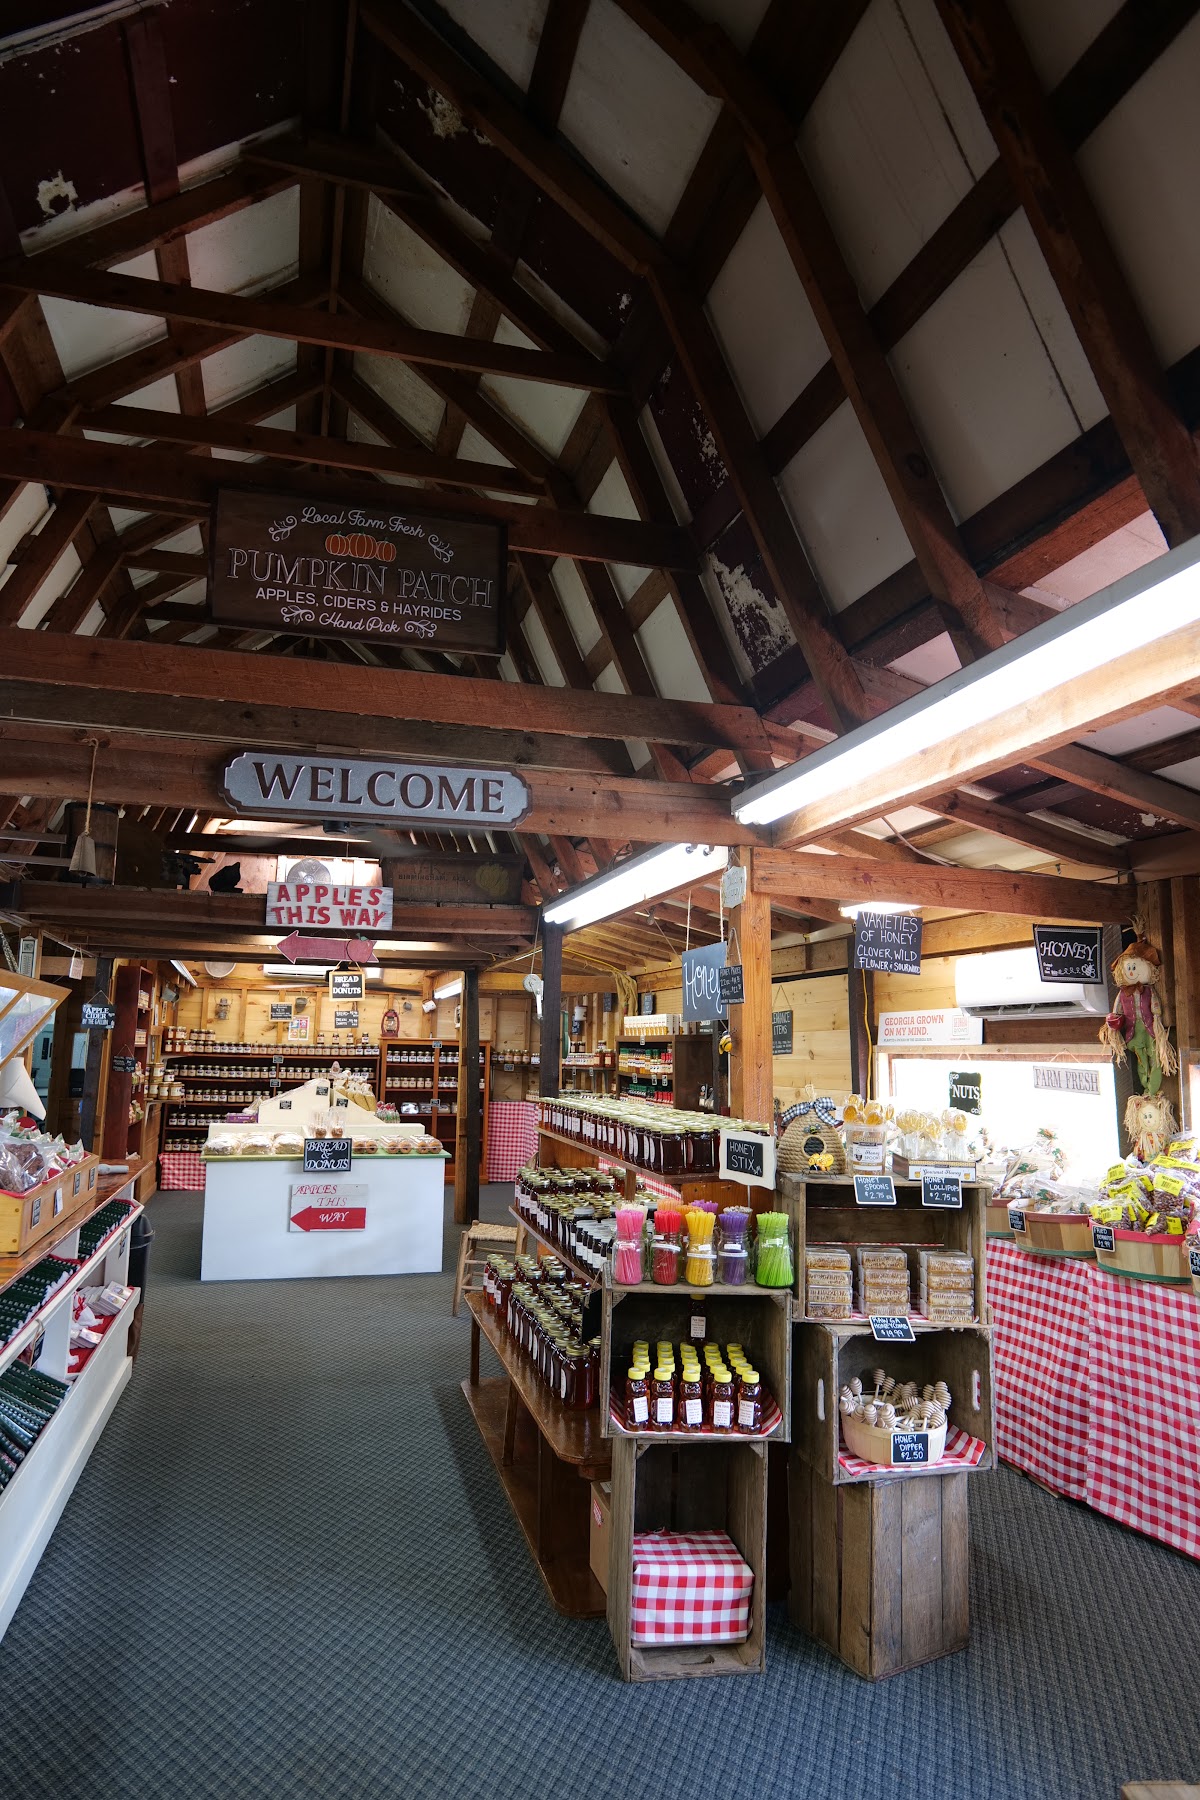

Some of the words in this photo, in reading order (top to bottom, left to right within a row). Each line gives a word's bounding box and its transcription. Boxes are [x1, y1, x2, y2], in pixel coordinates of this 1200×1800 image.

[301, 506, 346, 525] Local
[348, 509, 387, 530] Farm
[389, 515, 425, 538] Fresh
[227, 547, 388, 595] PUMPKIN
[397, 568, 493, 608] PATCH
[255, 587, 319, 606] APPLES,
[323, 594, 376, 612] CIDERS
[380, 600, 389, 613] &
[393, 602, 462, 621] HAYRIDES
[319, 612, 365, 631] Hand
[366, 617, 400, 633] Pick
[252, 761, 505, 815] WELCOME
[276, 884, 383, 906] APPLES
[271, 905, 331, 924] THIS
[339, 908, 387, 928] WAY
[861, 911, 918, 933] VARIETIES
[860, 929, 875, 943] OF
[880, 929, 916, 945] HONEY:
[857, 944, 893, 960] CLOVER,
[894, 948, 917, 961] WILD
[1040, 940, 1098, 961] HONEY
[334, 975, 359, 983] BREAD
[683, 958, 722, 1014] Honey
[885, 1016, 914, 1026] GEORGIA
[916, 1014, 944, 1024] GROWN
[773, 1025, 788, 1035] ITEMS
[884, 1028, 894, 1036] ON
[896, 1028, 906, 1036] MY
[908, 1027, 928, 1036] MIND.
[1035, 1068, 1061, 1088] FARM
[1065, 1071, 1099, 1092] FRESH
[951, 1084, 980, 1100] NUTS
[307, 1141, 347, 1152] BREAD
[730, 1141, 755, 1157] HONEY
[321, 1151, 333, 1159] &
[731, 1154, 755, 1170] STIX
[306, 1158, 349, 1169] DONUTS
[944, 1169, 962, 1177] Honey
[293, 1184, 337, 1196] APPLES
[317, 1197, 347, 1207] THIS
[319, 1211, 349, 1223] WAY
[1093, 1226, 1108, 1235] FRIED
[894, 1434, 917, 1444] HONEY
[899, 1443, 924, 1451] DIPPER
[901, 1451, 924, 1460] $2.50
